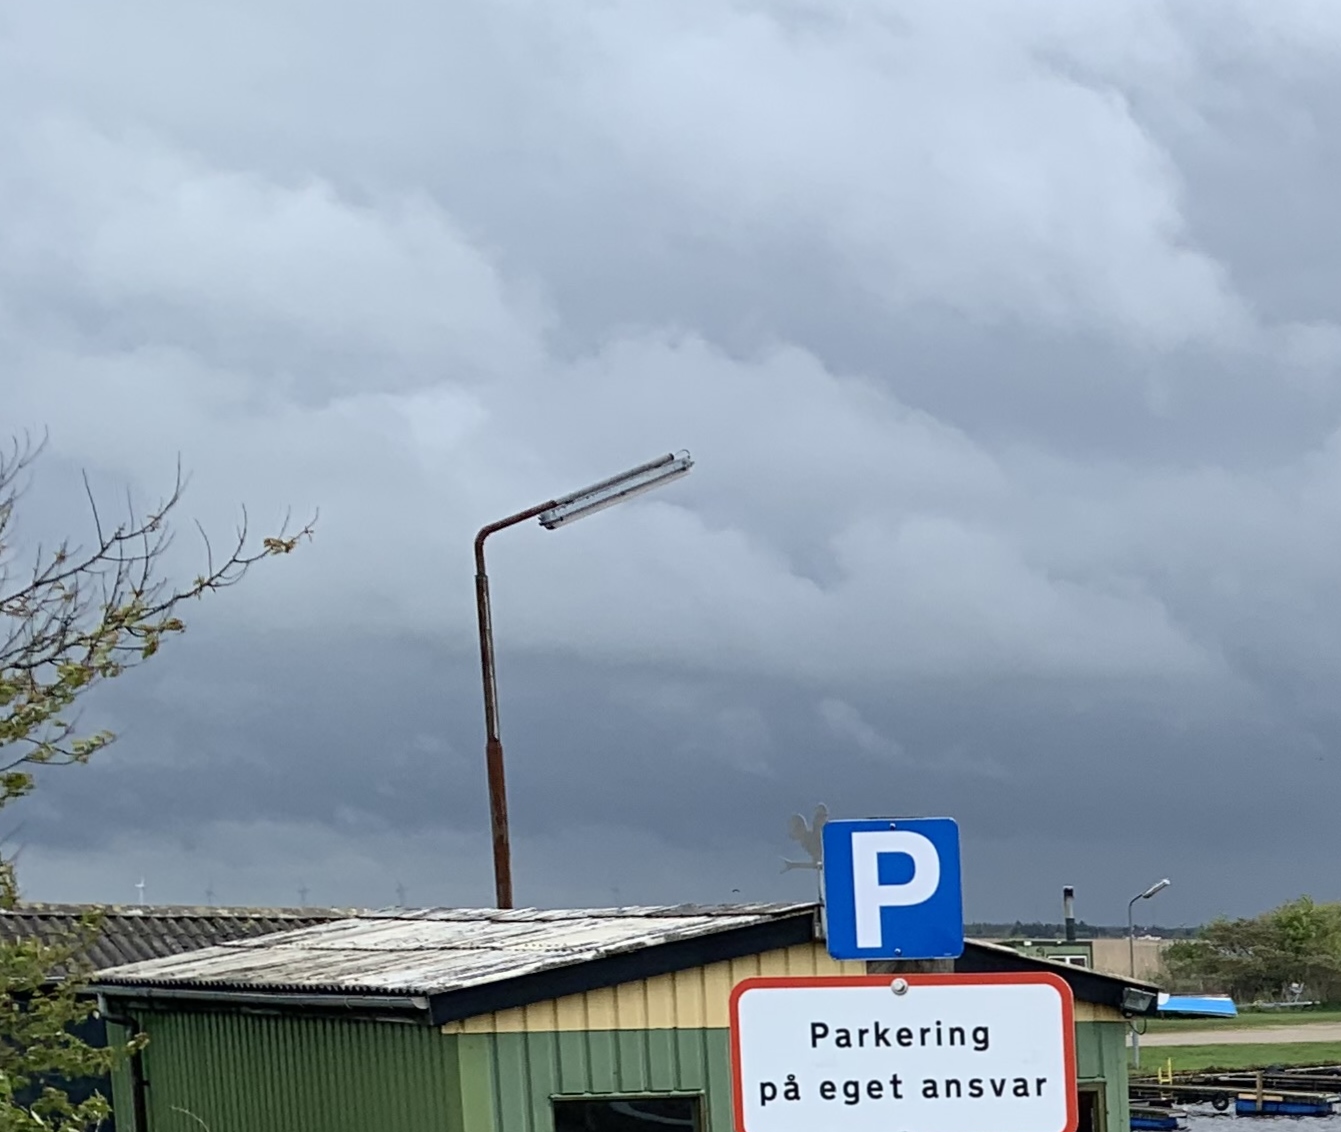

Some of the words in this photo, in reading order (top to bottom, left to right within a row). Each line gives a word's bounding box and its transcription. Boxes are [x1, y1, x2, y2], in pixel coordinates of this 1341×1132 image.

[851, 830, 941, 948] P
[810, 1020, 990, 1052] Parkering
[759, 1073, 801, 1107] på
[819, 1073, 903, 1106] eget
[921, 1076, 1048, 1099] ansvar
